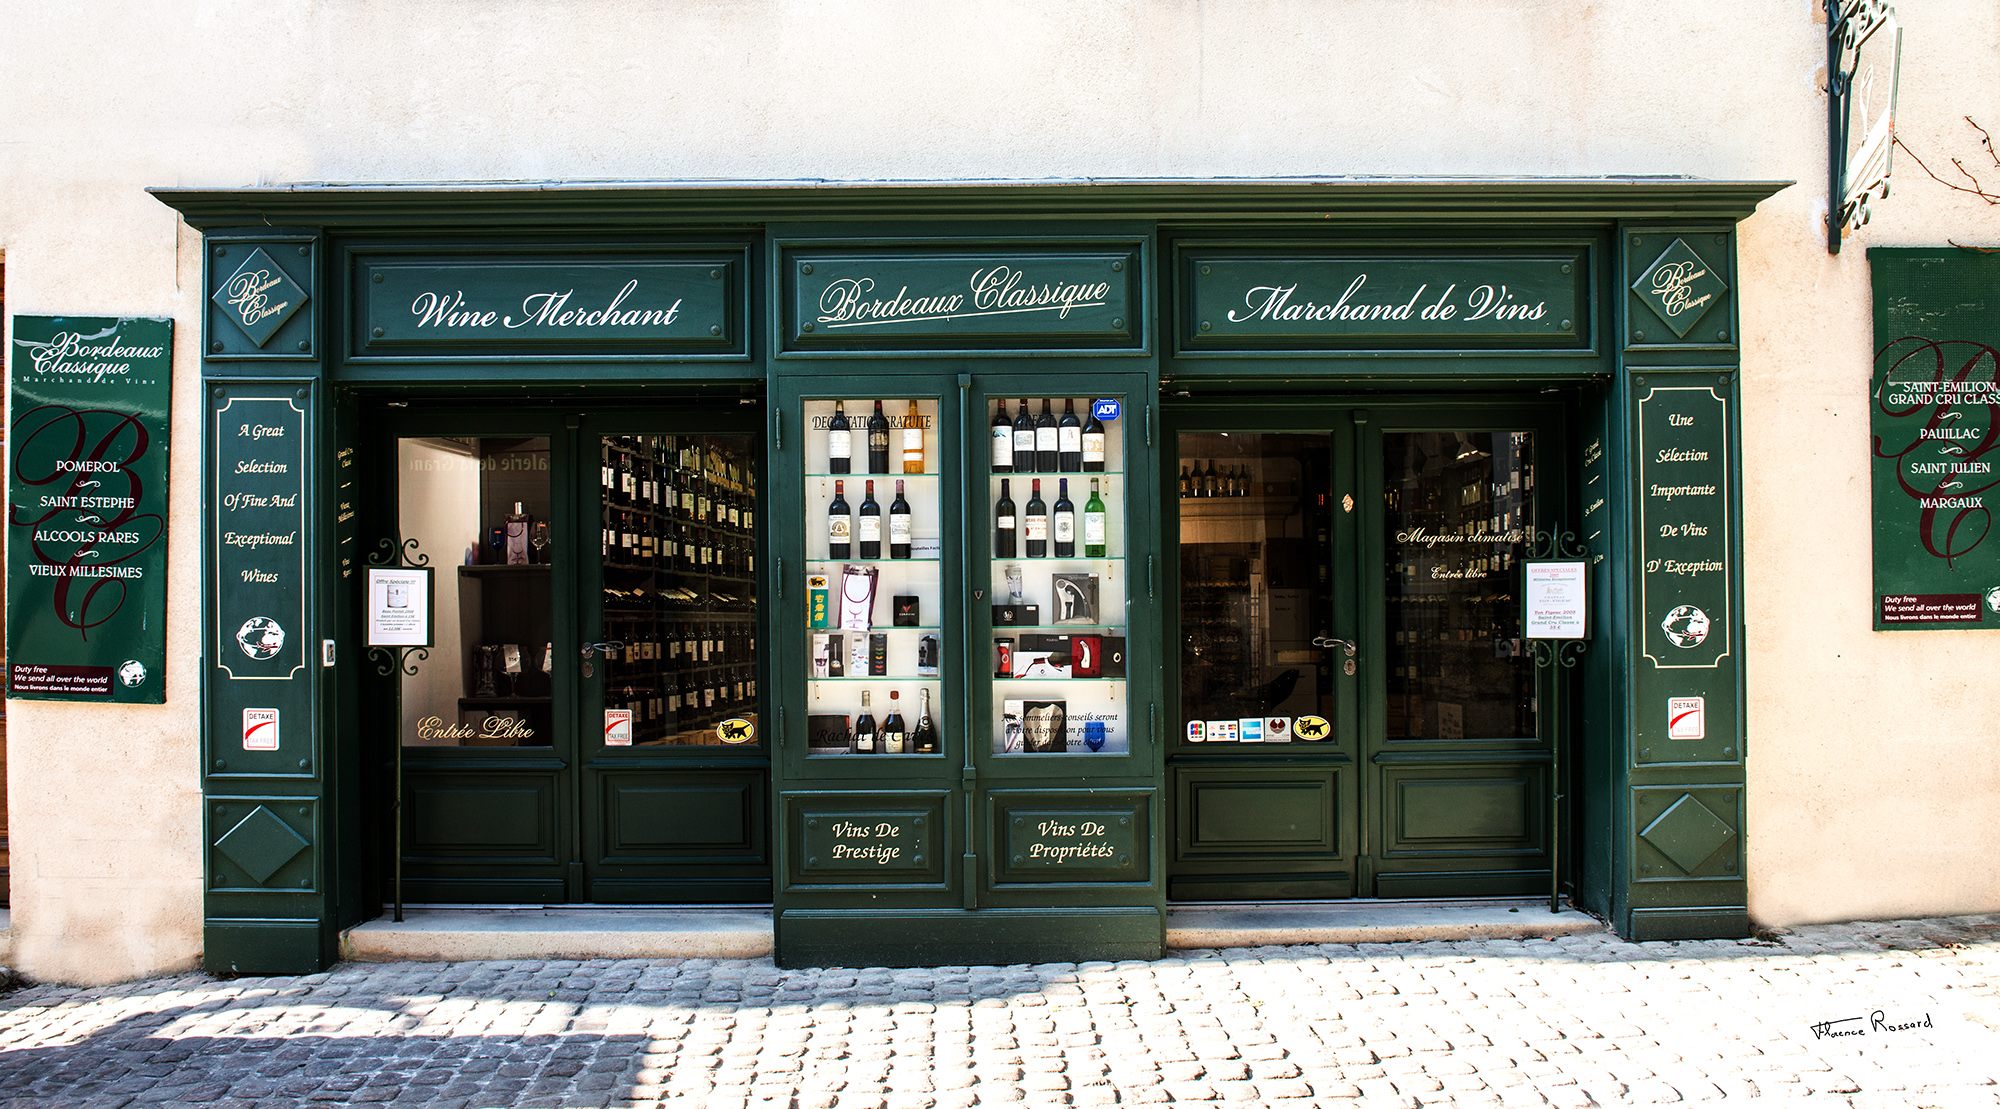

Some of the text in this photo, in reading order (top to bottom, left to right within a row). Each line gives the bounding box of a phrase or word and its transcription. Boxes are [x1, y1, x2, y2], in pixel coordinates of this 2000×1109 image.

[1651, 261, 1706, 295] Bordeaux
[228, 269, 282, 304] Bordeaux
[817, 265, 1111, 322] Bordeaux Classique
[411, 278, 683, 329] Wine Merchant
[1227, 273, 1548, 323] Marchand de Vins
[1662, 285, 1712, 317] Classique
[238, 294, 288, 326] Classique
[50, 331, 164, 359] Bordeaux
[30, 346, 131, 384] Classique
[23, 376, 92, 385] Marchand
[101, 377, 116, 385] de
[1903, 381, 1996, 393] SAINT-EMILION
[1888, 393, 1934, 404] GRAND
[1935, 393, 1962, 405] CRU
[1097, 404, 1117, 415] ADT
[1668, 413, 1694, 427] Une
[238, 424, 285, 440] A Great
[1920, 428, 1980, 439] PAUILLAC
[1655, 447, 1709, 463] Sélection
[56, 460, 121, 473] POMEROL
[234, 459, 288, 474] Selection
[1911, 462, 1991, 474] SAINT JULIEN
[1650, 484, 1716, 501] Importante
[40, 495, 135, 509] SAINT ESTEPHE
[223, 492, 298, 512] Of Fine And
[1920, 497, 1983, 509] MARGAUX
[34, 530, 140, 544] ALCOOLS RARES
[1660, 522, 1708, 537] De Vins
[224, 531, 297, 550] Exceptional
[1397, 526, 1525, 549] Magasin climatisé
[28, 564, 143, 579] VIEUX MILLESIMES
[1430, 566, 1488, 580] Entrée libre
[1646, 558, 1723, 577] D' Exception
[240, 569, 279, 583] Wines
[1884, 595, 1917, 604] Duty free
[1898, 604, 1915, 612] send
[1942, 603, 1955, 611] the
[1955, 603, 1977, 611] world
[15, 665, 48, 674] Duty free
[14, 674, 26, 682] We
[27, 674, 45, 682] send
[46, 675, 55, 683] all
[73, 675, 86, 683] the
[86, 676, 108, 684] world
[1095, 713, 1118, 721] seront
[417, 715, 535, 741] Entrée Libre
[831, 820, 900, 838] Vins De
[1037, 820, 1105, 837] Vins De
[832, 843, 901, 865] Prestige
[1029, 842, 1114, 864] Propriétés
